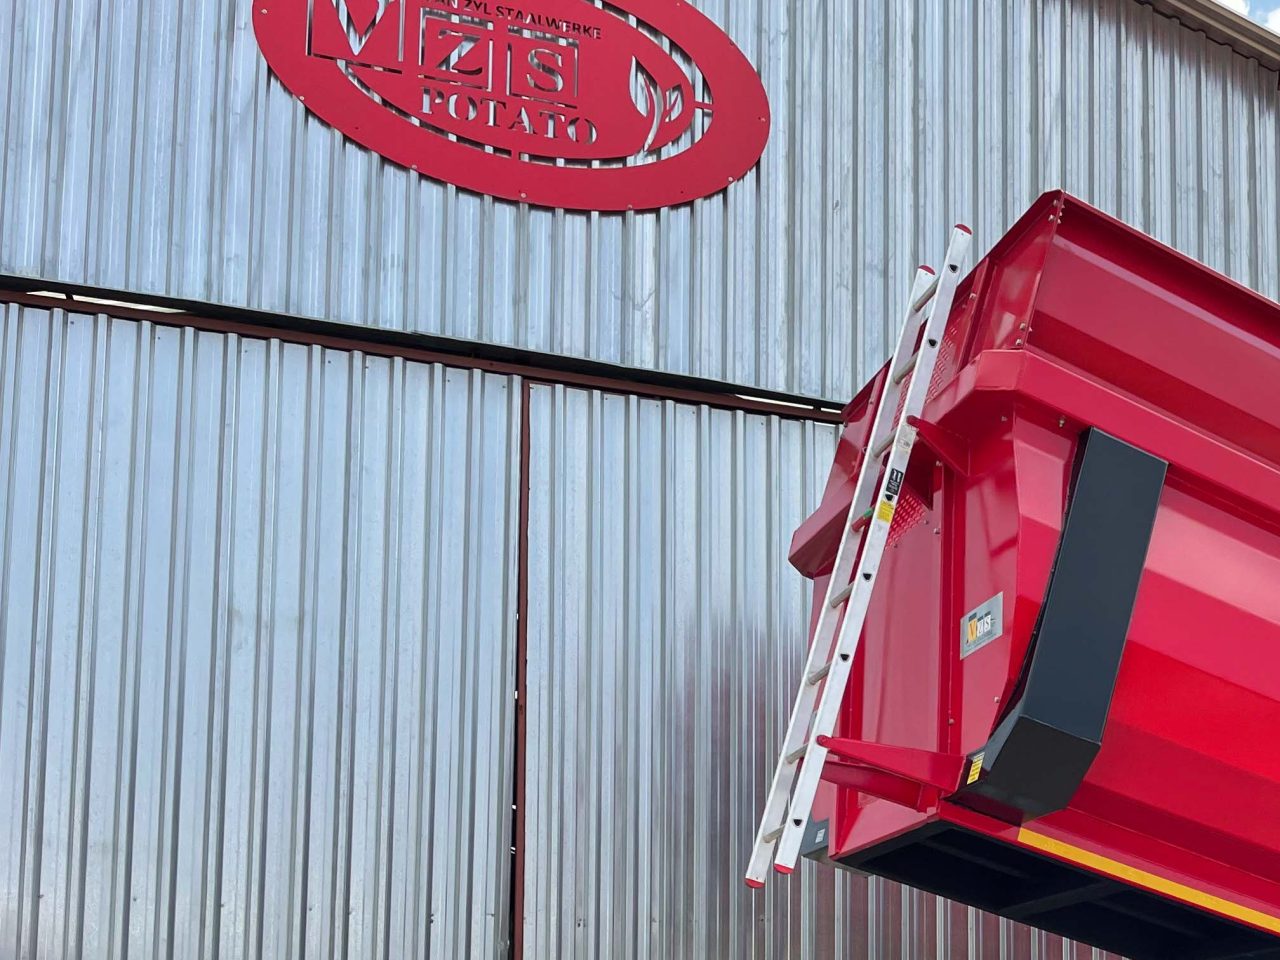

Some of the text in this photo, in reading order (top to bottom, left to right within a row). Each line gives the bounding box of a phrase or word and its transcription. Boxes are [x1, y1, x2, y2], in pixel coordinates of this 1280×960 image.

[464, 0, 491, 15] ZYL
[496, 5, 602, 39] STAALWERKE
[420, 86, 598, 145] POTATO
